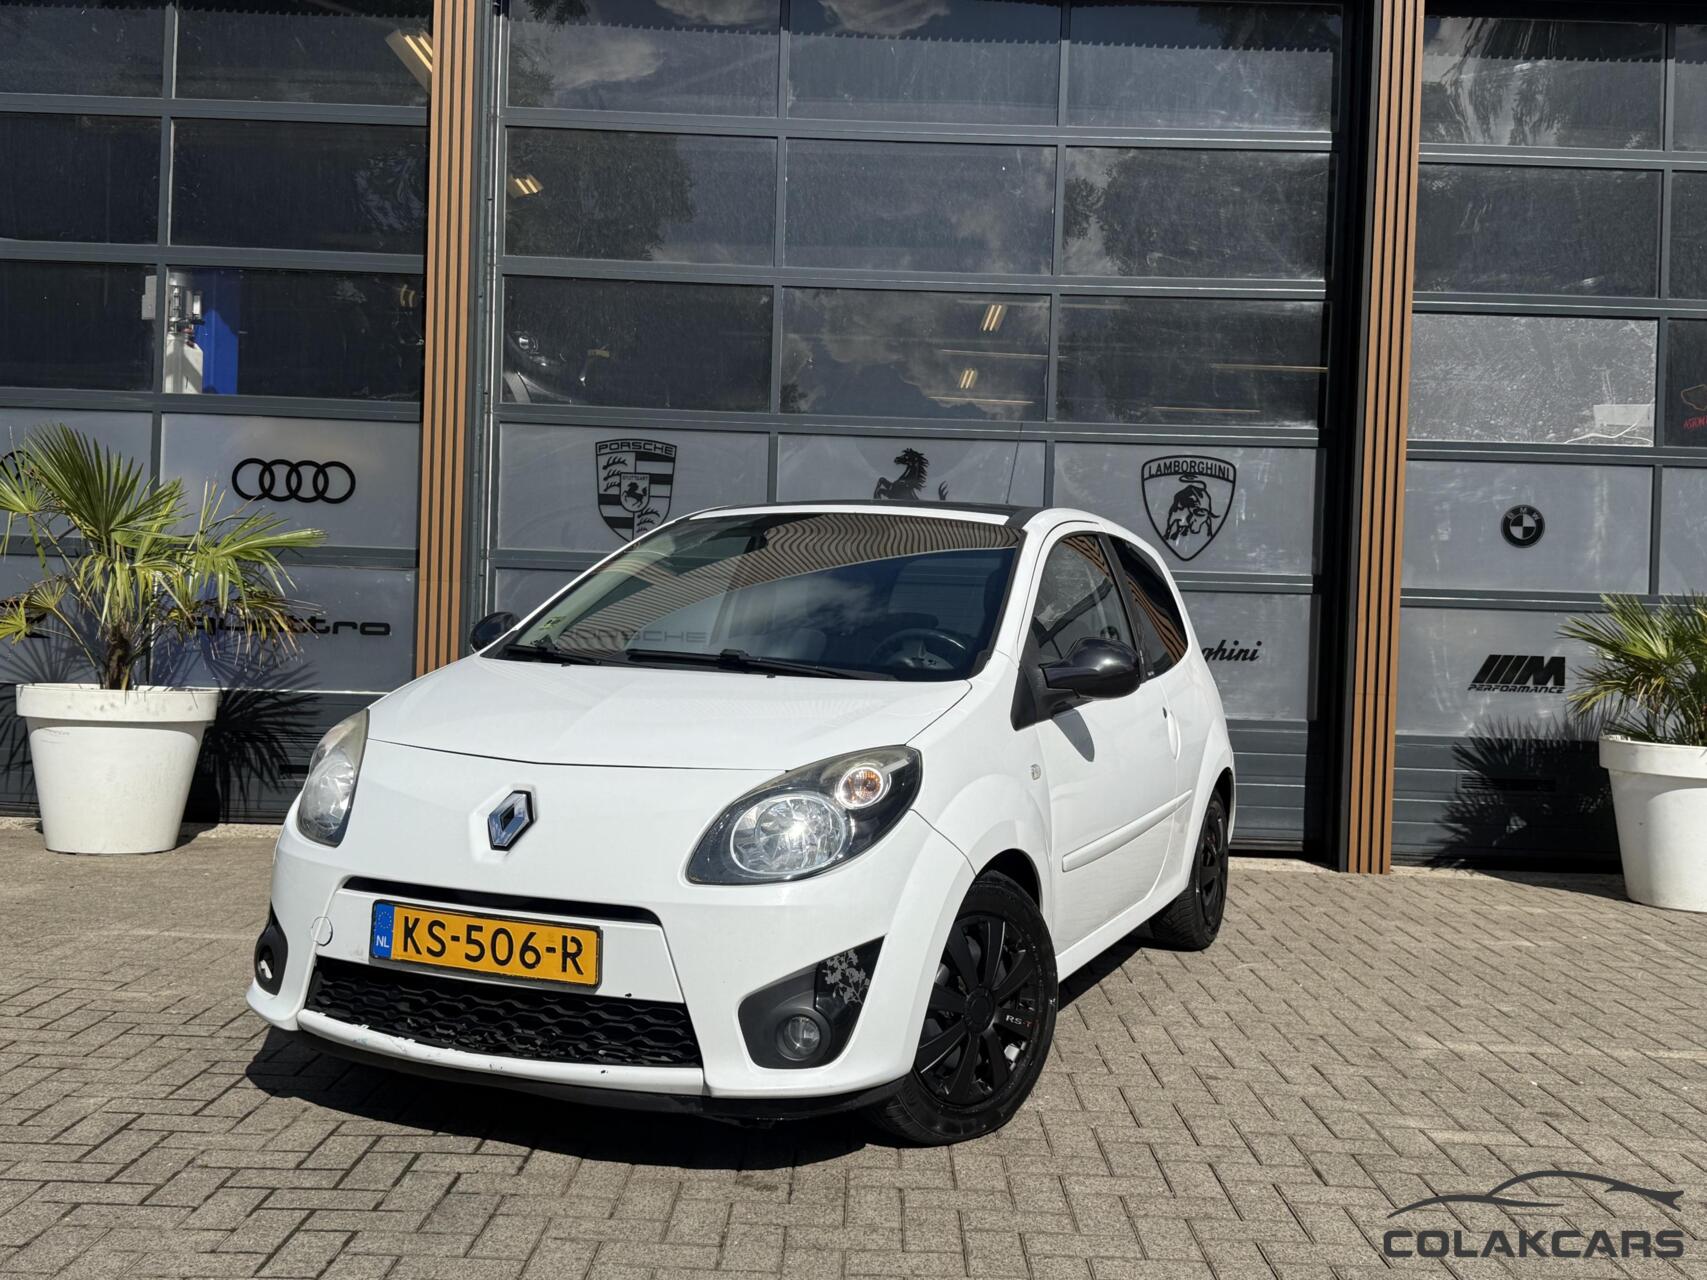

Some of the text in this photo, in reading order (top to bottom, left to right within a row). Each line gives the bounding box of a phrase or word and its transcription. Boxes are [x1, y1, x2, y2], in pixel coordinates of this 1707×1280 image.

[598, 441, 675, 456] PORSCHE
[1148, 460, 1230, 480] LAMBORGHINI
[1468, 684, 1566, 694] PERFORMANCE
[375, 935, 390, 948] NL
[403, 915, 584, 975] KS-506-R
